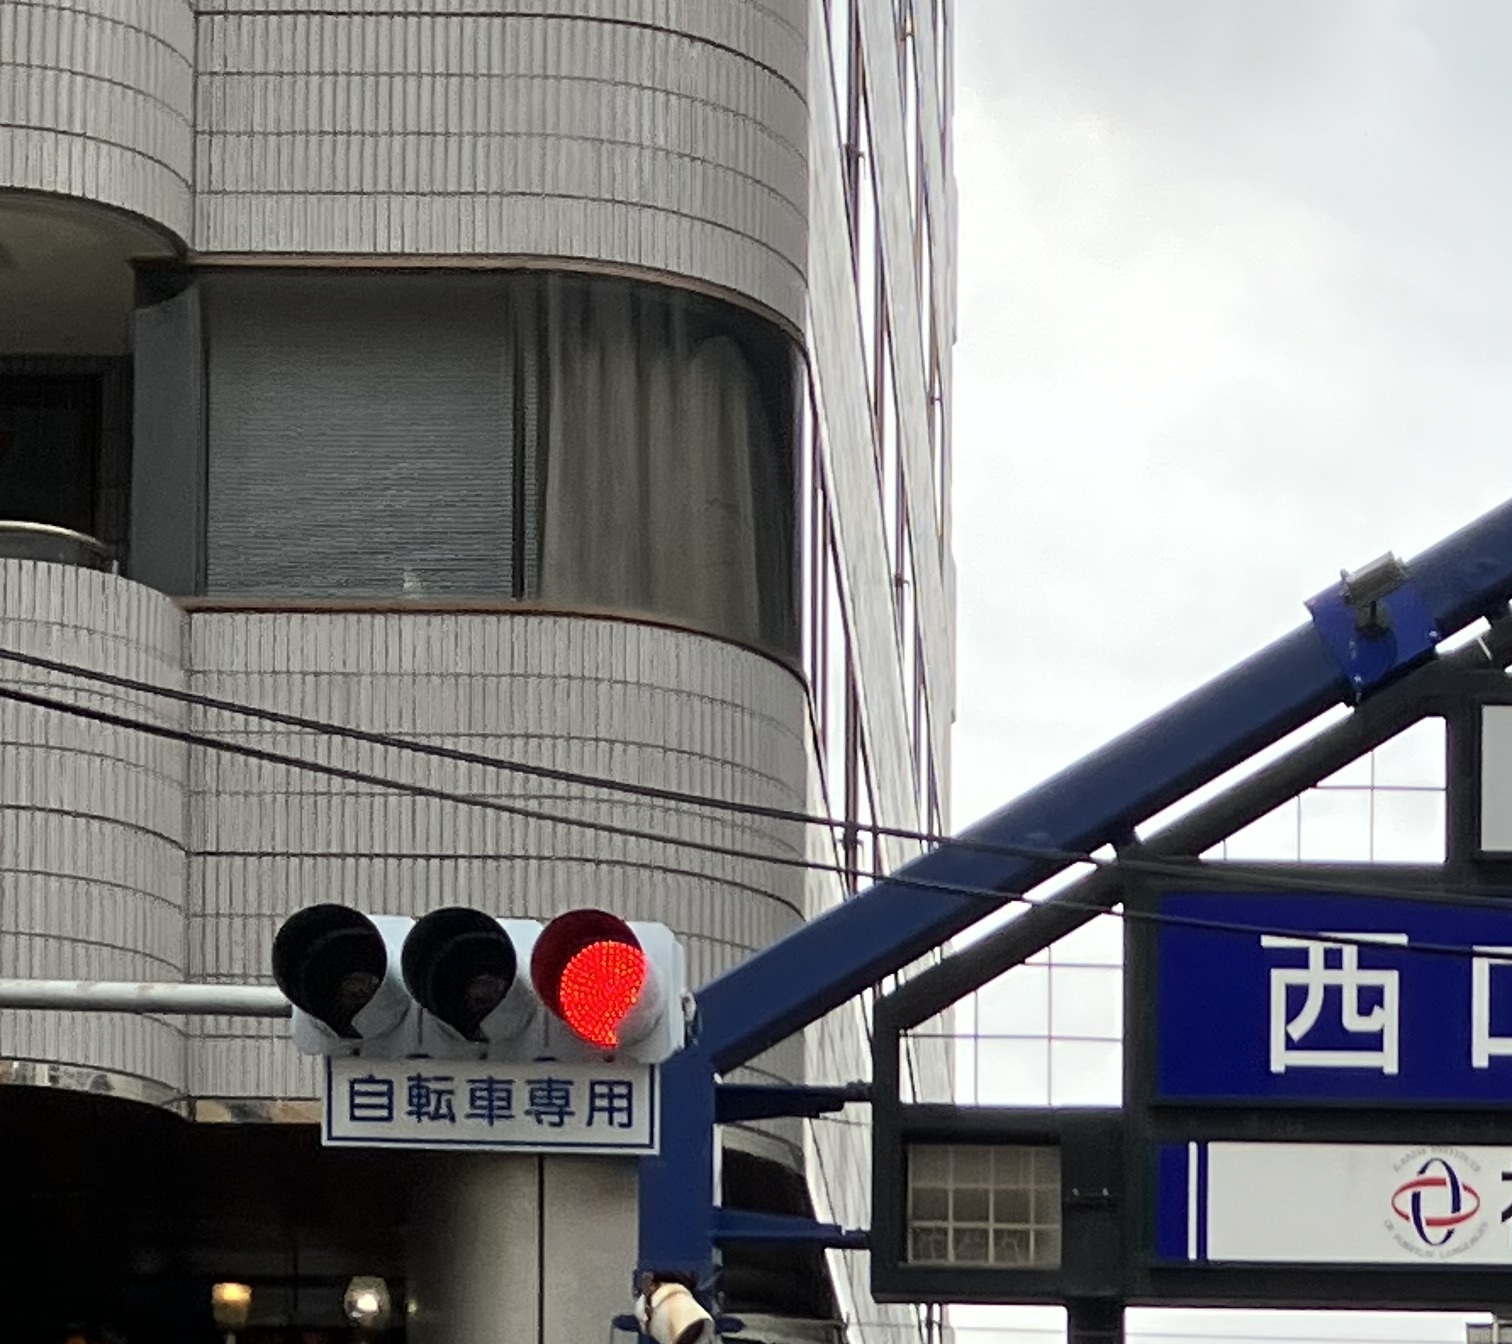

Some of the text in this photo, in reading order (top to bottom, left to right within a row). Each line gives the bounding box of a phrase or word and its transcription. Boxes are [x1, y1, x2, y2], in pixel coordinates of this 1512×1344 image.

[350, 1073, 634, 1128] 自転車専用
